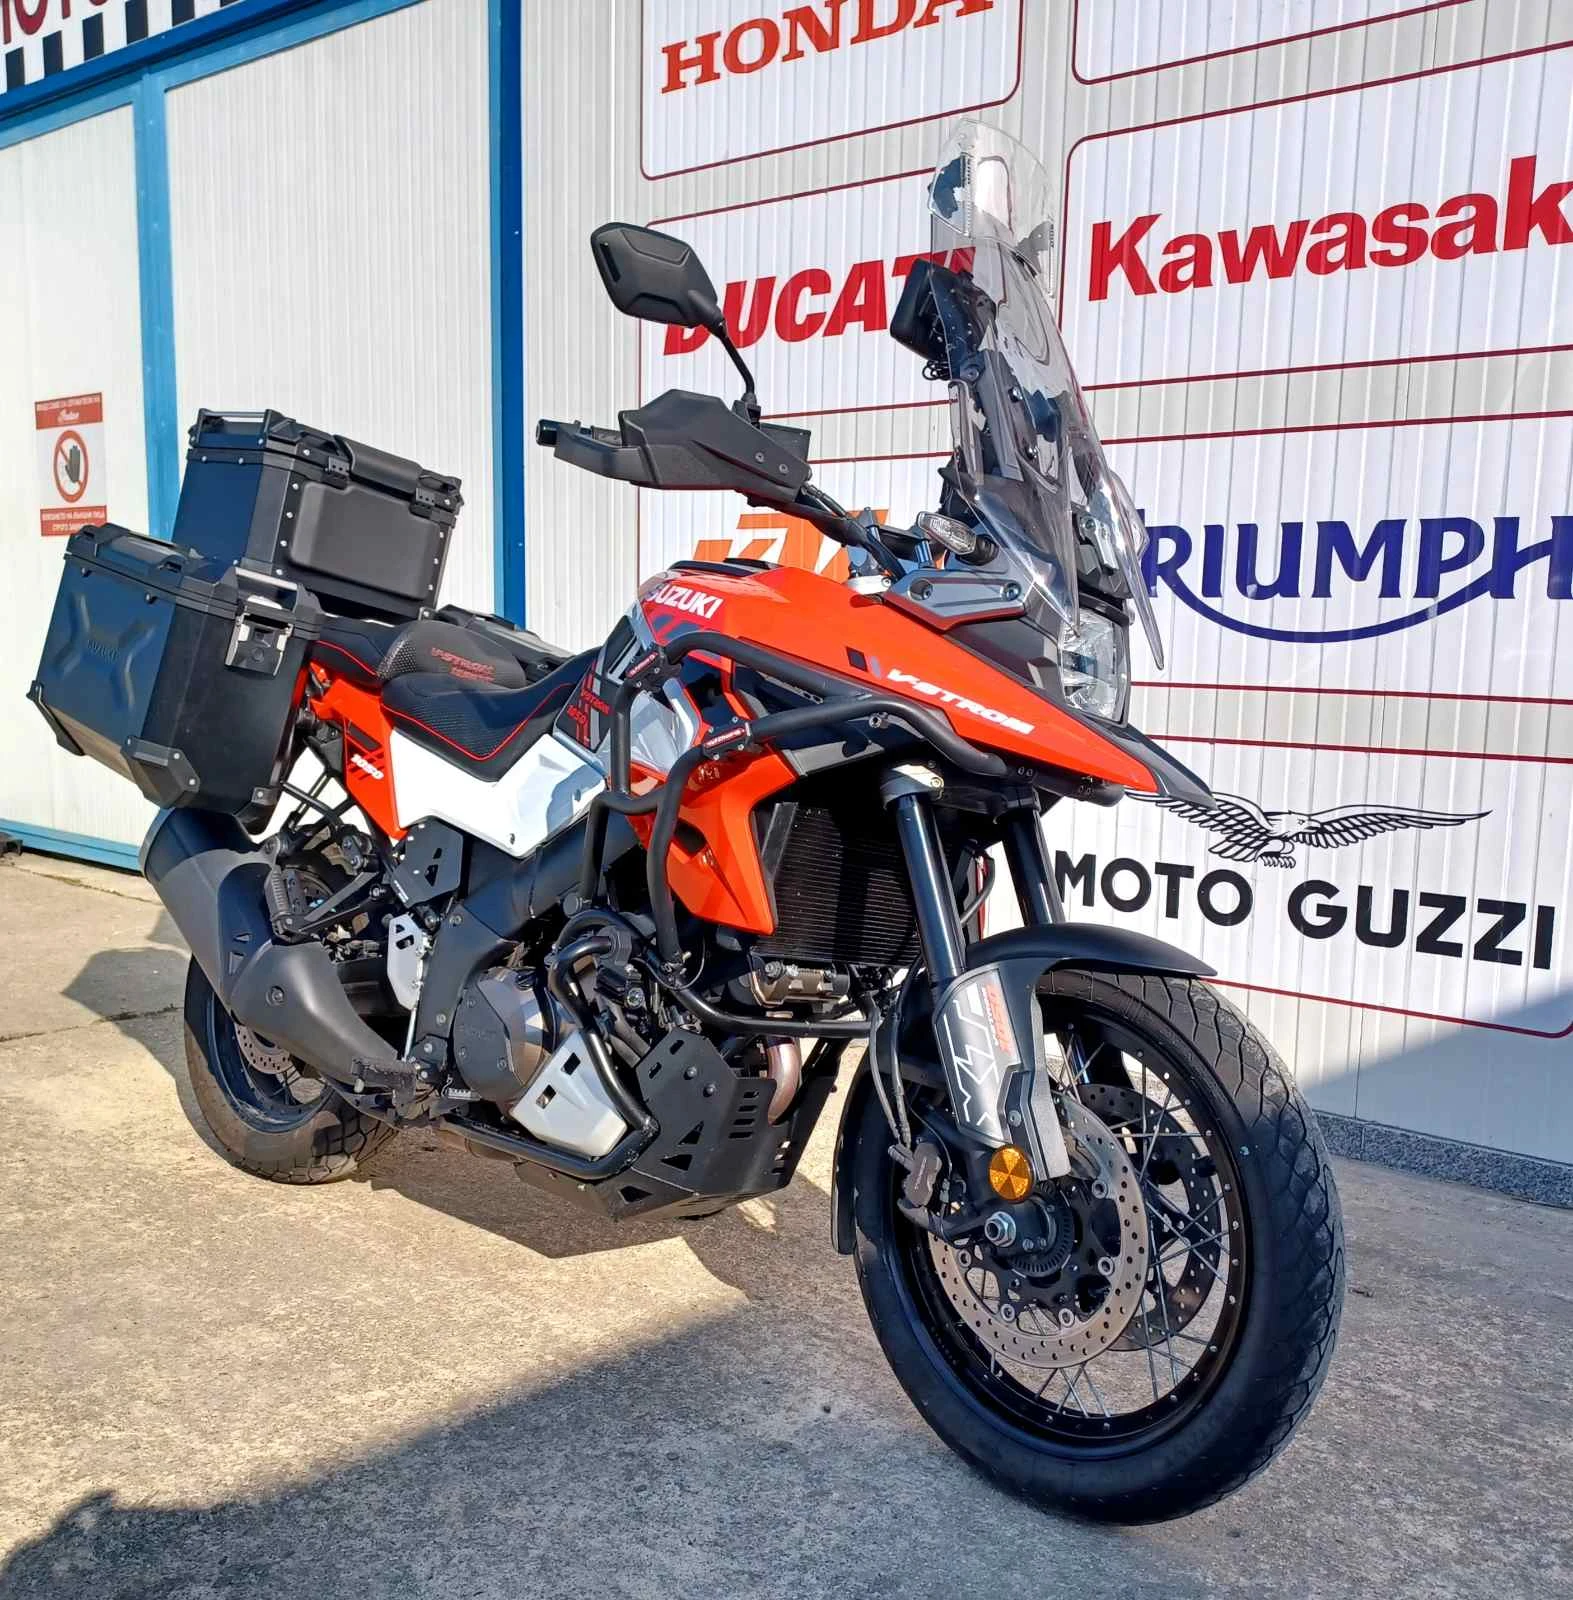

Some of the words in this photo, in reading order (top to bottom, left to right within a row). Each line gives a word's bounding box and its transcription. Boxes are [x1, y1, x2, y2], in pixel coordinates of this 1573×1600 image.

[1136, 508, 1573, 643] RIUMPH
[887, 668, 1035, 735] V-STROM
[1054, 850, 1254, 927] MOTO
[1287, 879, 1556, 970] GUZZI
